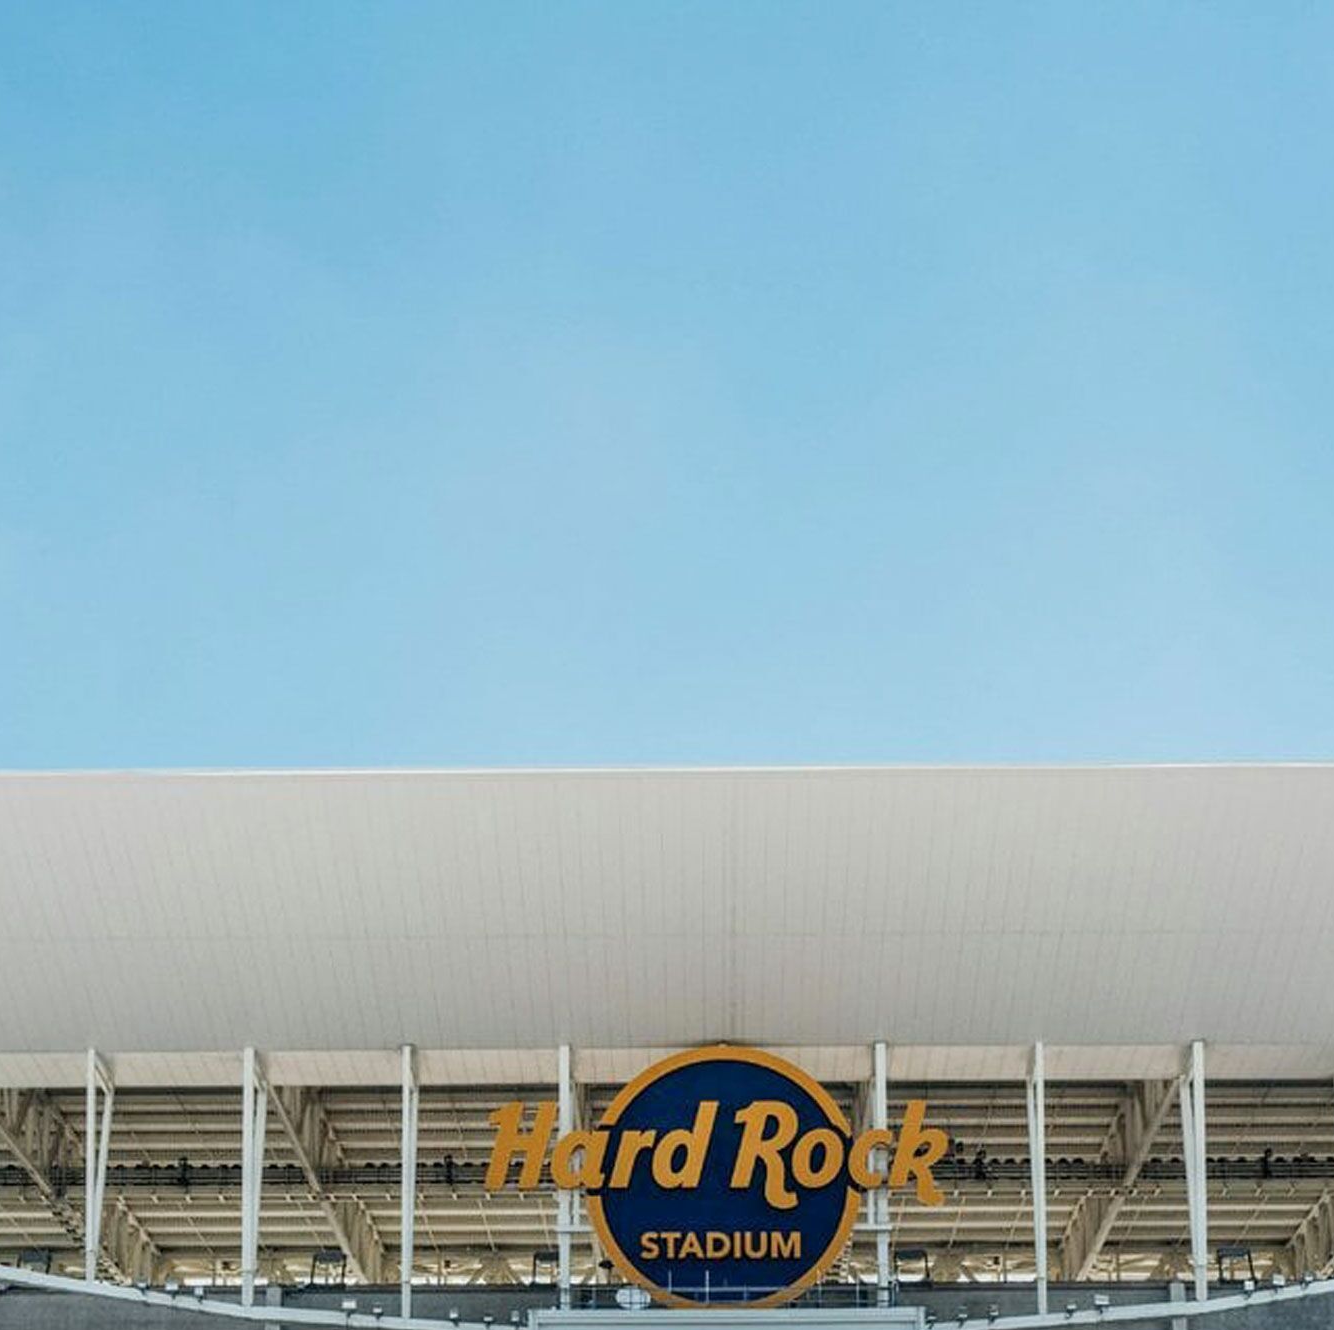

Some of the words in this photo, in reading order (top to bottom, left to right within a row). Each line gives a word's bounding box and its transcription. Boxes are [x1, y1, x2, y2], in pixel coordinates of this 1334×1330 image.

[484, 1100, 719, 1192] Hard
[730, 1100, 950, 1210] Rock
[639, 1230, 803, 1260] STADIUM
